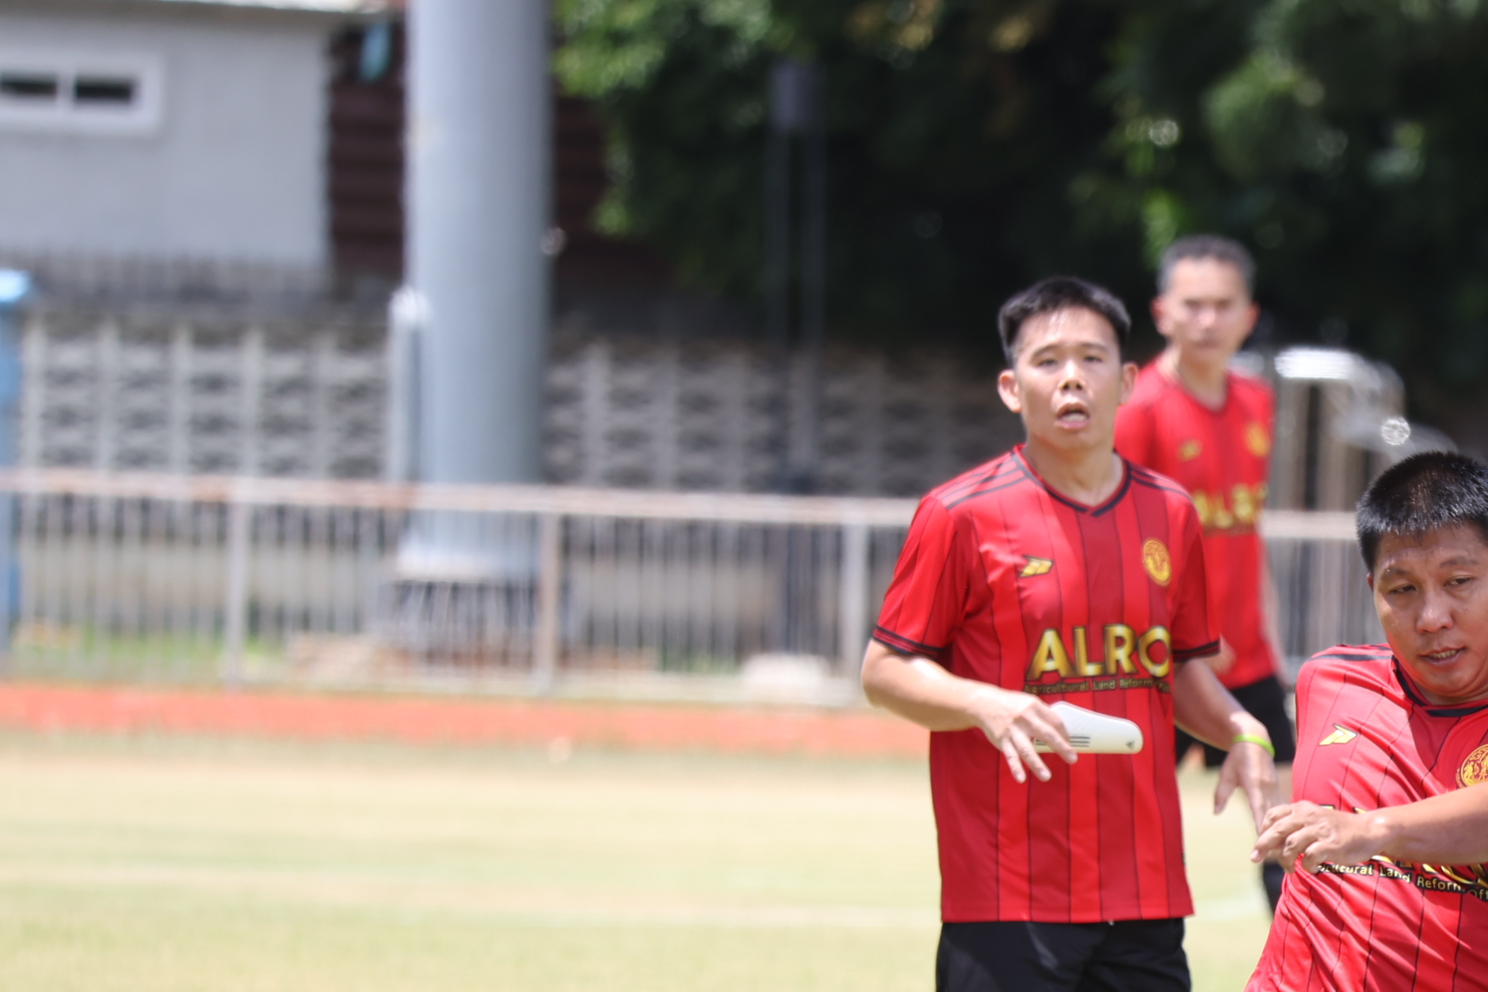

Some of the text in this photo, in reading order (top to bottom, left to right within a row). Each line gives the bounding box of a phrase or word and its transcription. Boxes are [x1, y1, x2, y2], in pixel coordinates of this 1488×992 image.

[1026, 623, 1171, 680] ALRO
[1093, 678, 1116, 690] Land
[1379, 865, 1411, 884] Land
